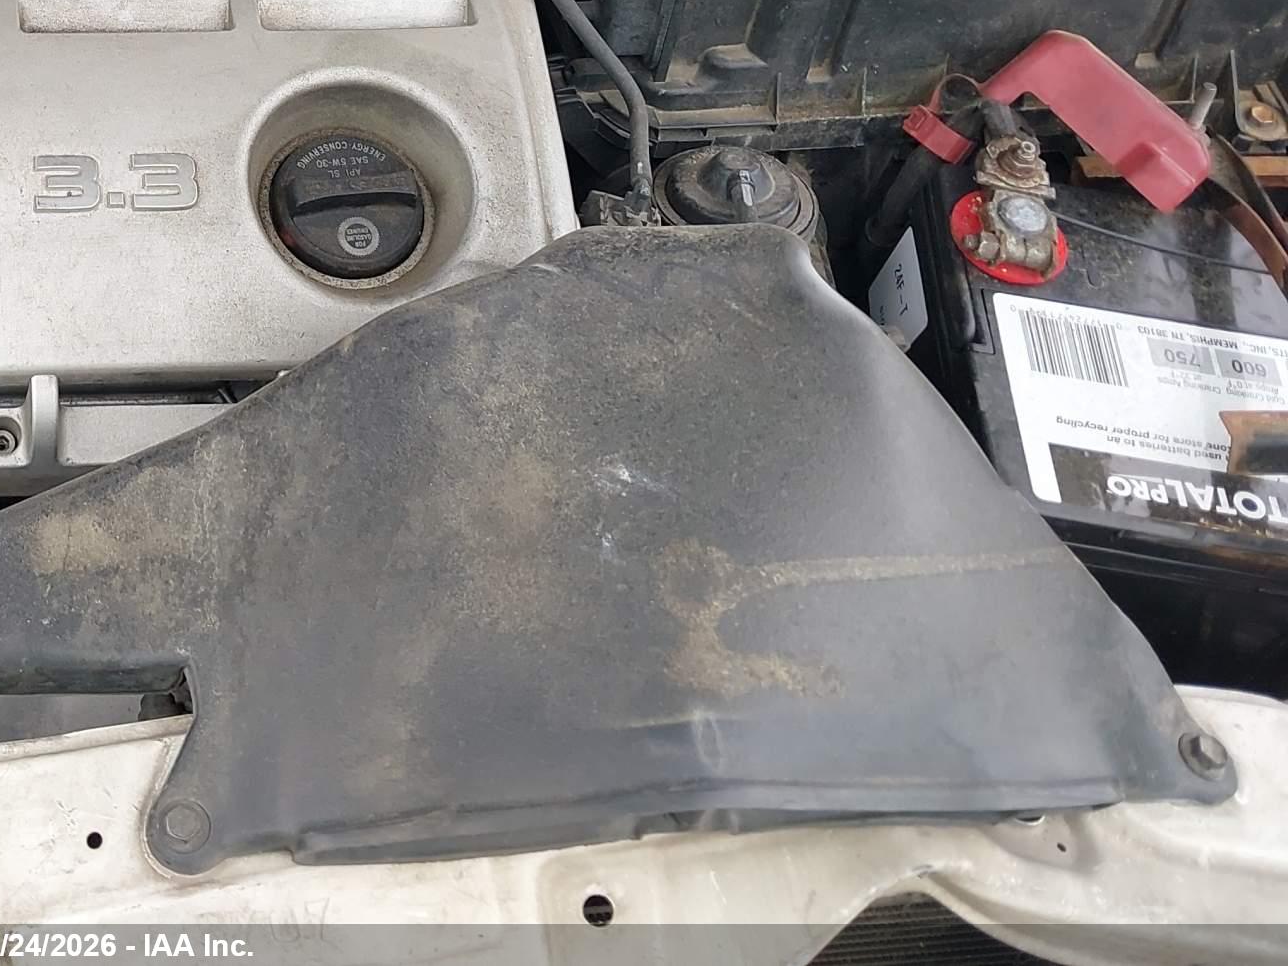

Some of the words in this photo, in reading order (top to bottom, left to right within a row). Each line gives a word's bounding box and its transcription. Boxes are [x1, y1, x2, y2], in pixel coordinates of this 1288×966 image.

[316, 159, 347, 168] 5W-30
[351, 156, 368, 164] SAE
[328, 170, 341, 178] SL
[346, 169, 361, 178] API
[32, 151, 201, 215] 3.3
[1137, 326, 1168, 338] 38103
[1170, 331, 1185, 340] TN
[1186, 333, 1238, 350] MEMPHIS,
[1164, 348, 1200, 368] 750
[1232, 359, 1266, 377] 600
[1056, 416, 1108, 432] recycling
[1112, 427, 1150, 440] proper
[1153, 434, 1170, 444] for
[1106, 435, 1120, 444] an
[1124, 438, 1136, 448] to
[1172, 438, 1203, 450] store
[1138, 440, 1192, 457] batteries
[1194, 450, 1222, 460] used
